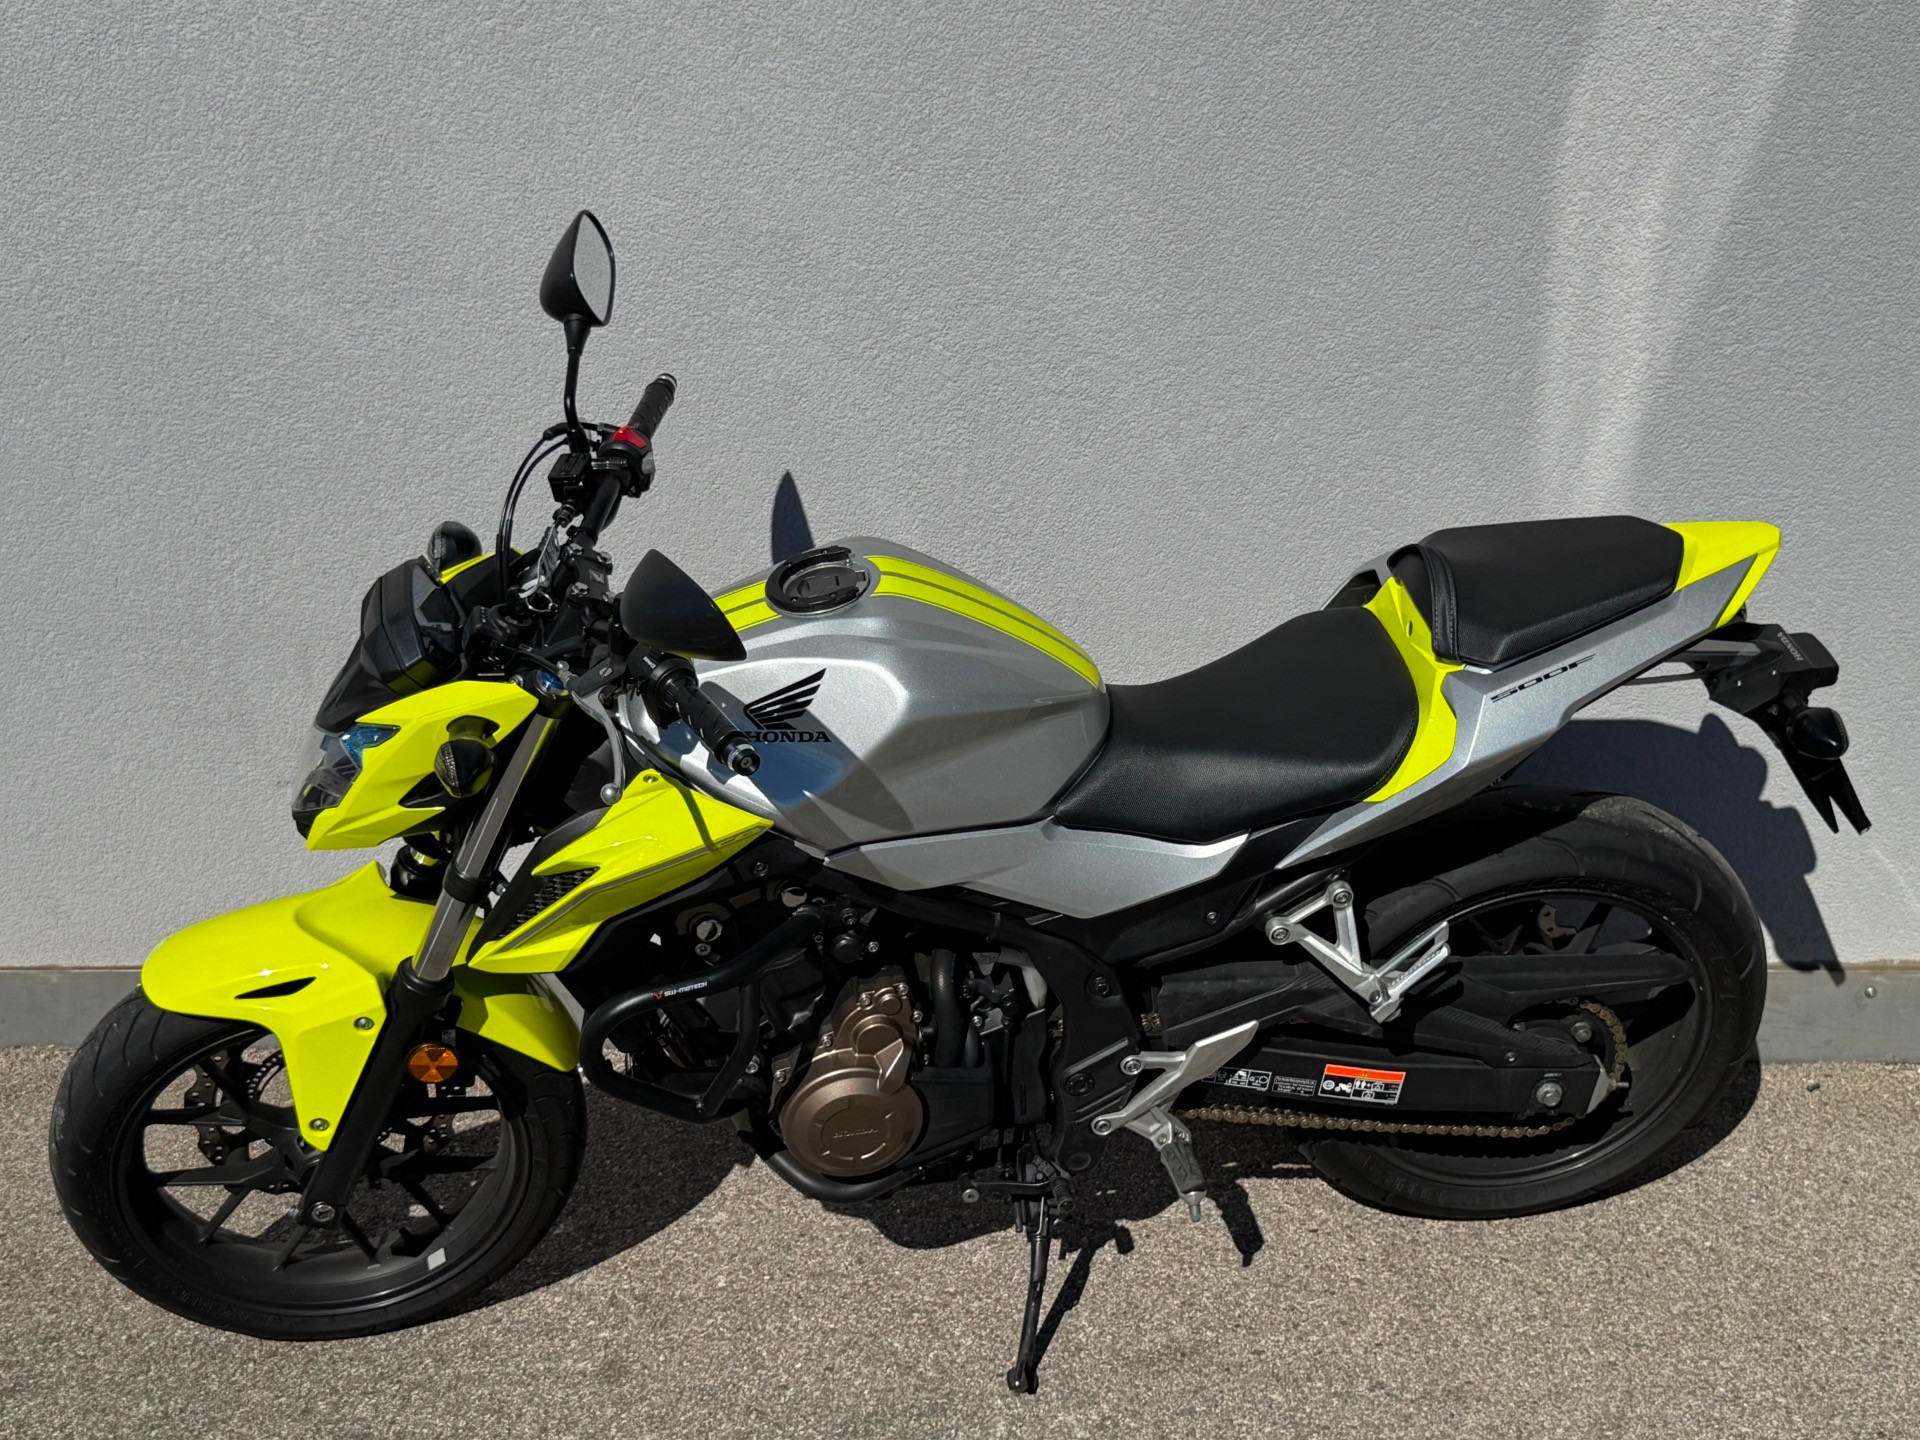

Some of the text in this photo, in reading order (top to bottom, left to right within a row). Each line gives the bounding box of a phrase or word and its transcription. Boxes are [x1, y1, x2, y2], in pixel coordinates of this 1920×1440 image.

[1777, 631, 1804, 661] HONDA
[1490, 653, 1596, 703] 500F
[746, 731, 832, 743] HONDA
